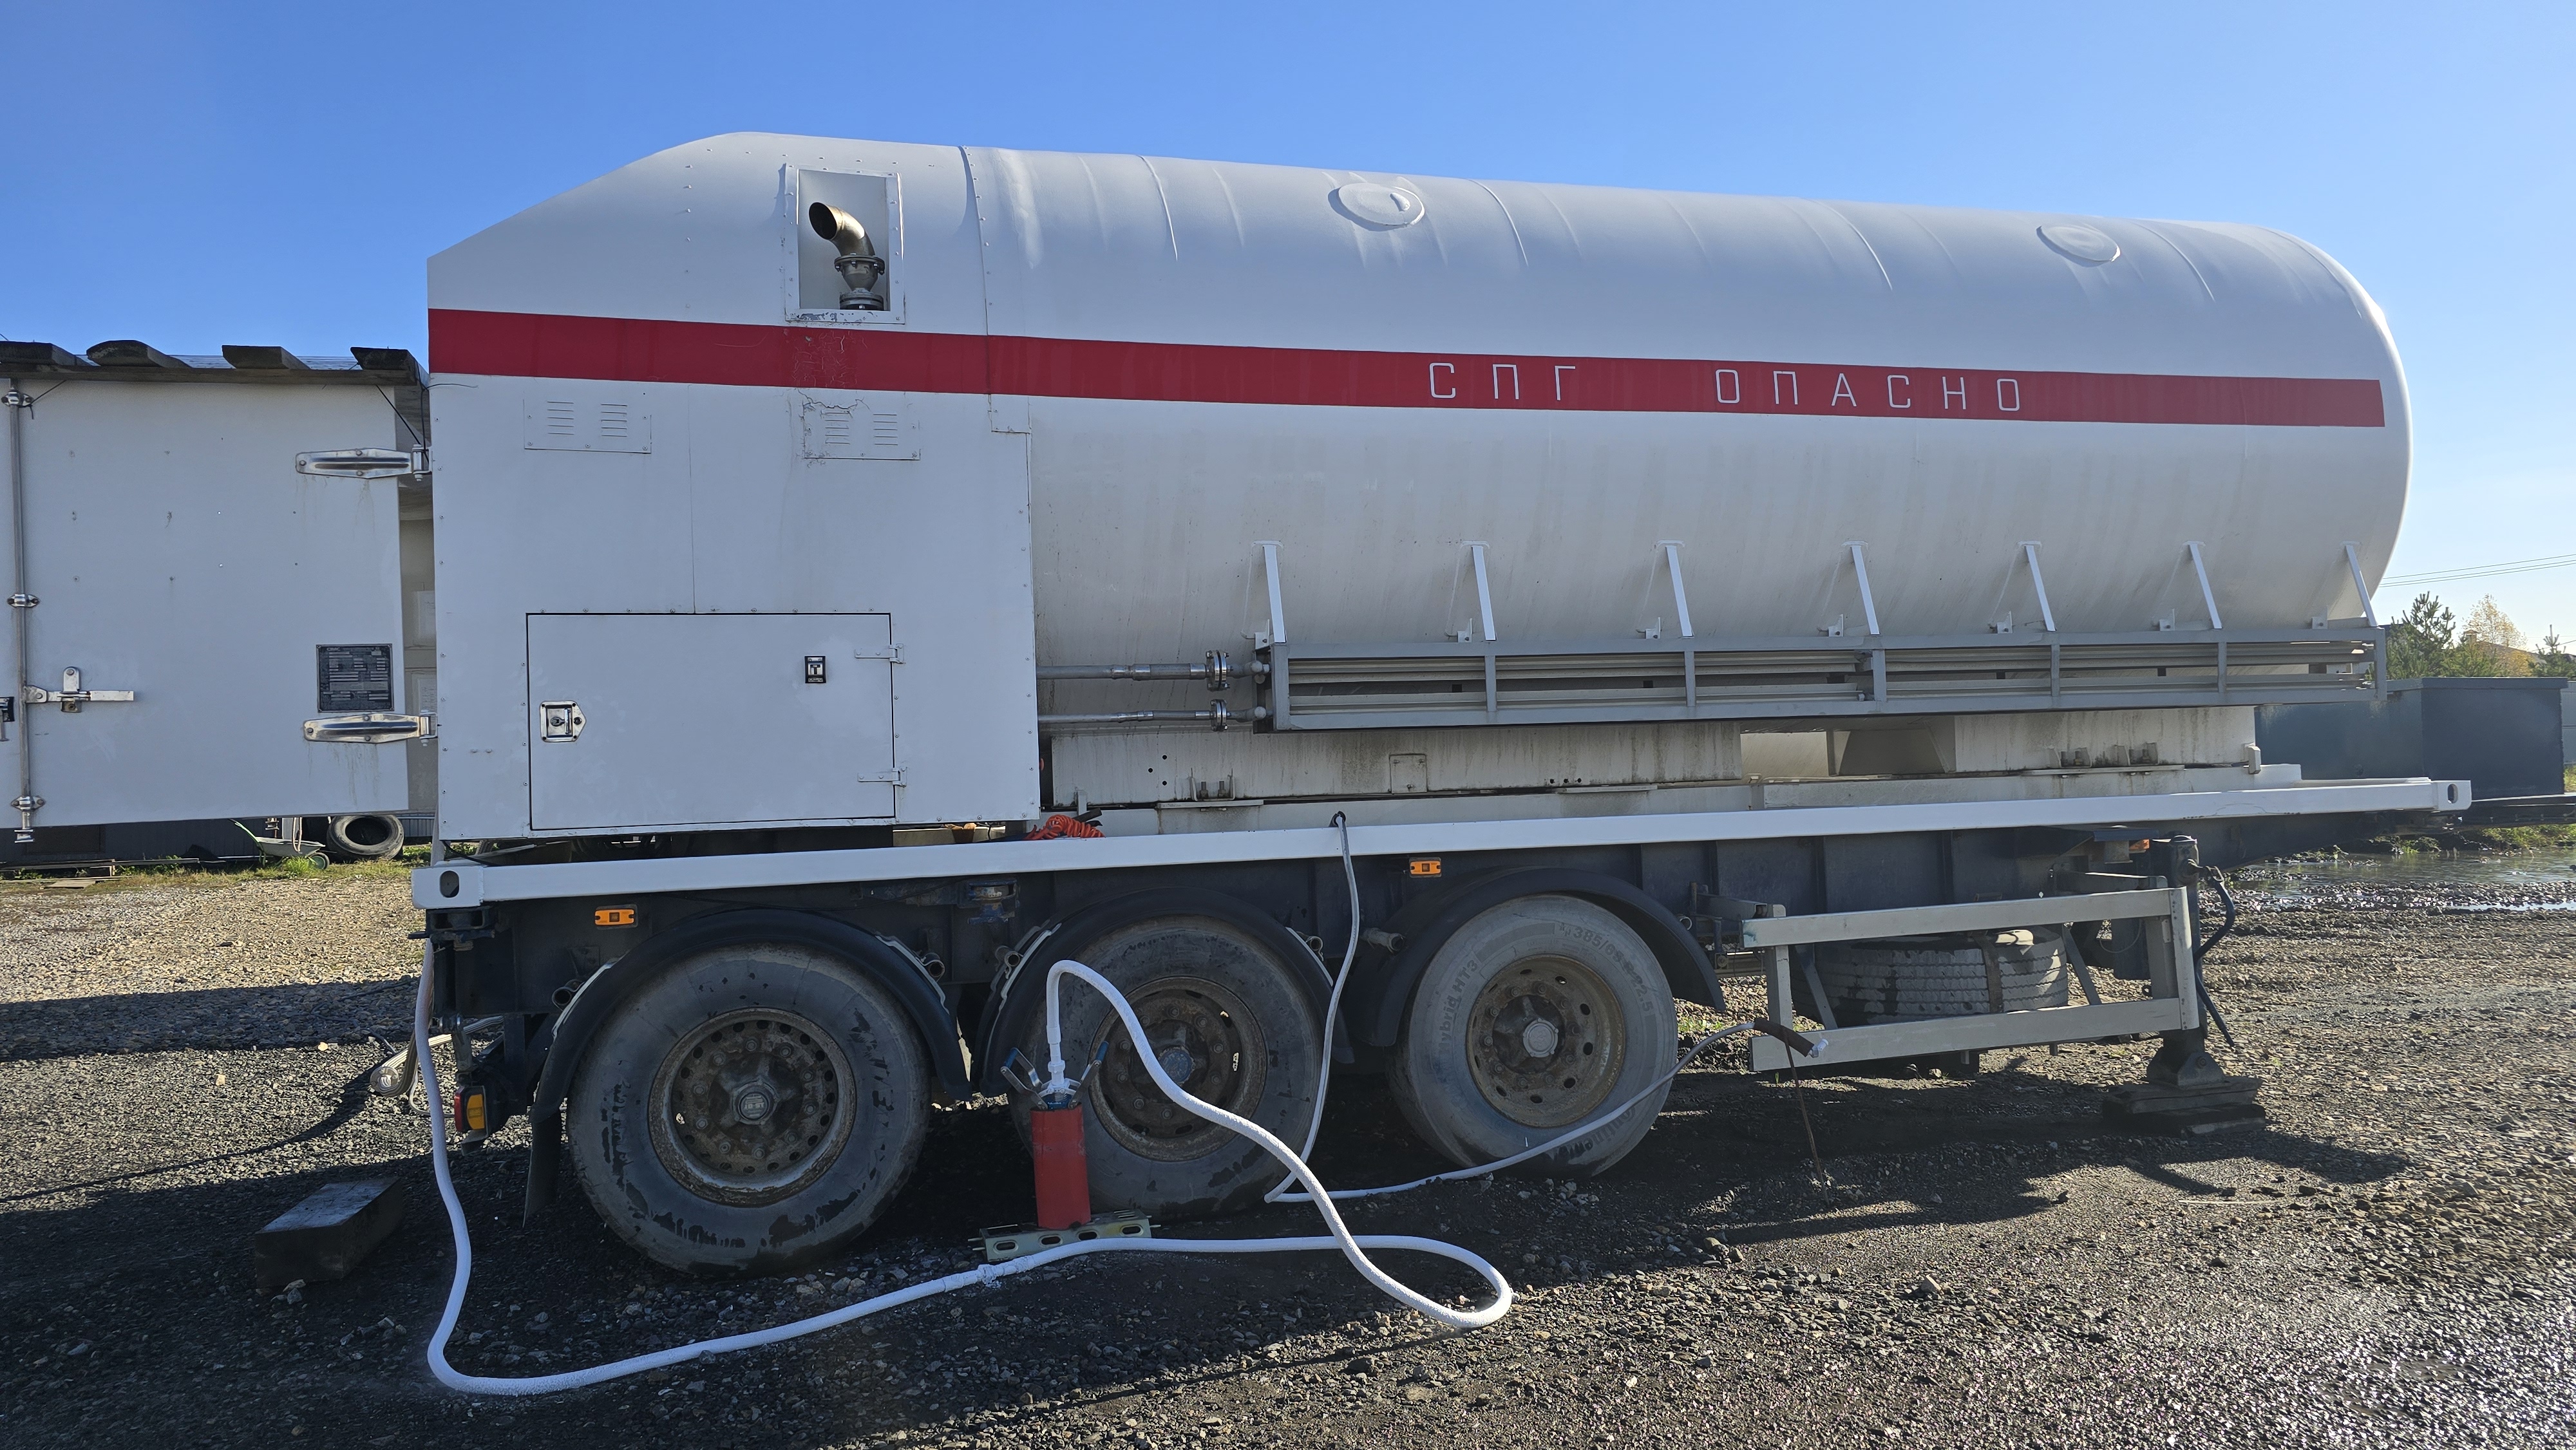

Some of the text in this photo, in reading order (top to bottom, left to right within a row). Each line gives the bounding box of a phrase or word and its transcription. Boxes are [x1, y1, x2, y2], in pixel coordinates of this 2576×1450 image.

[1429, 362, 2020, 411] СПГ ОПАСНО
[1439, 995, 1461, 1056] Hybrid
[1452, 960, 1477, 993] HT3
